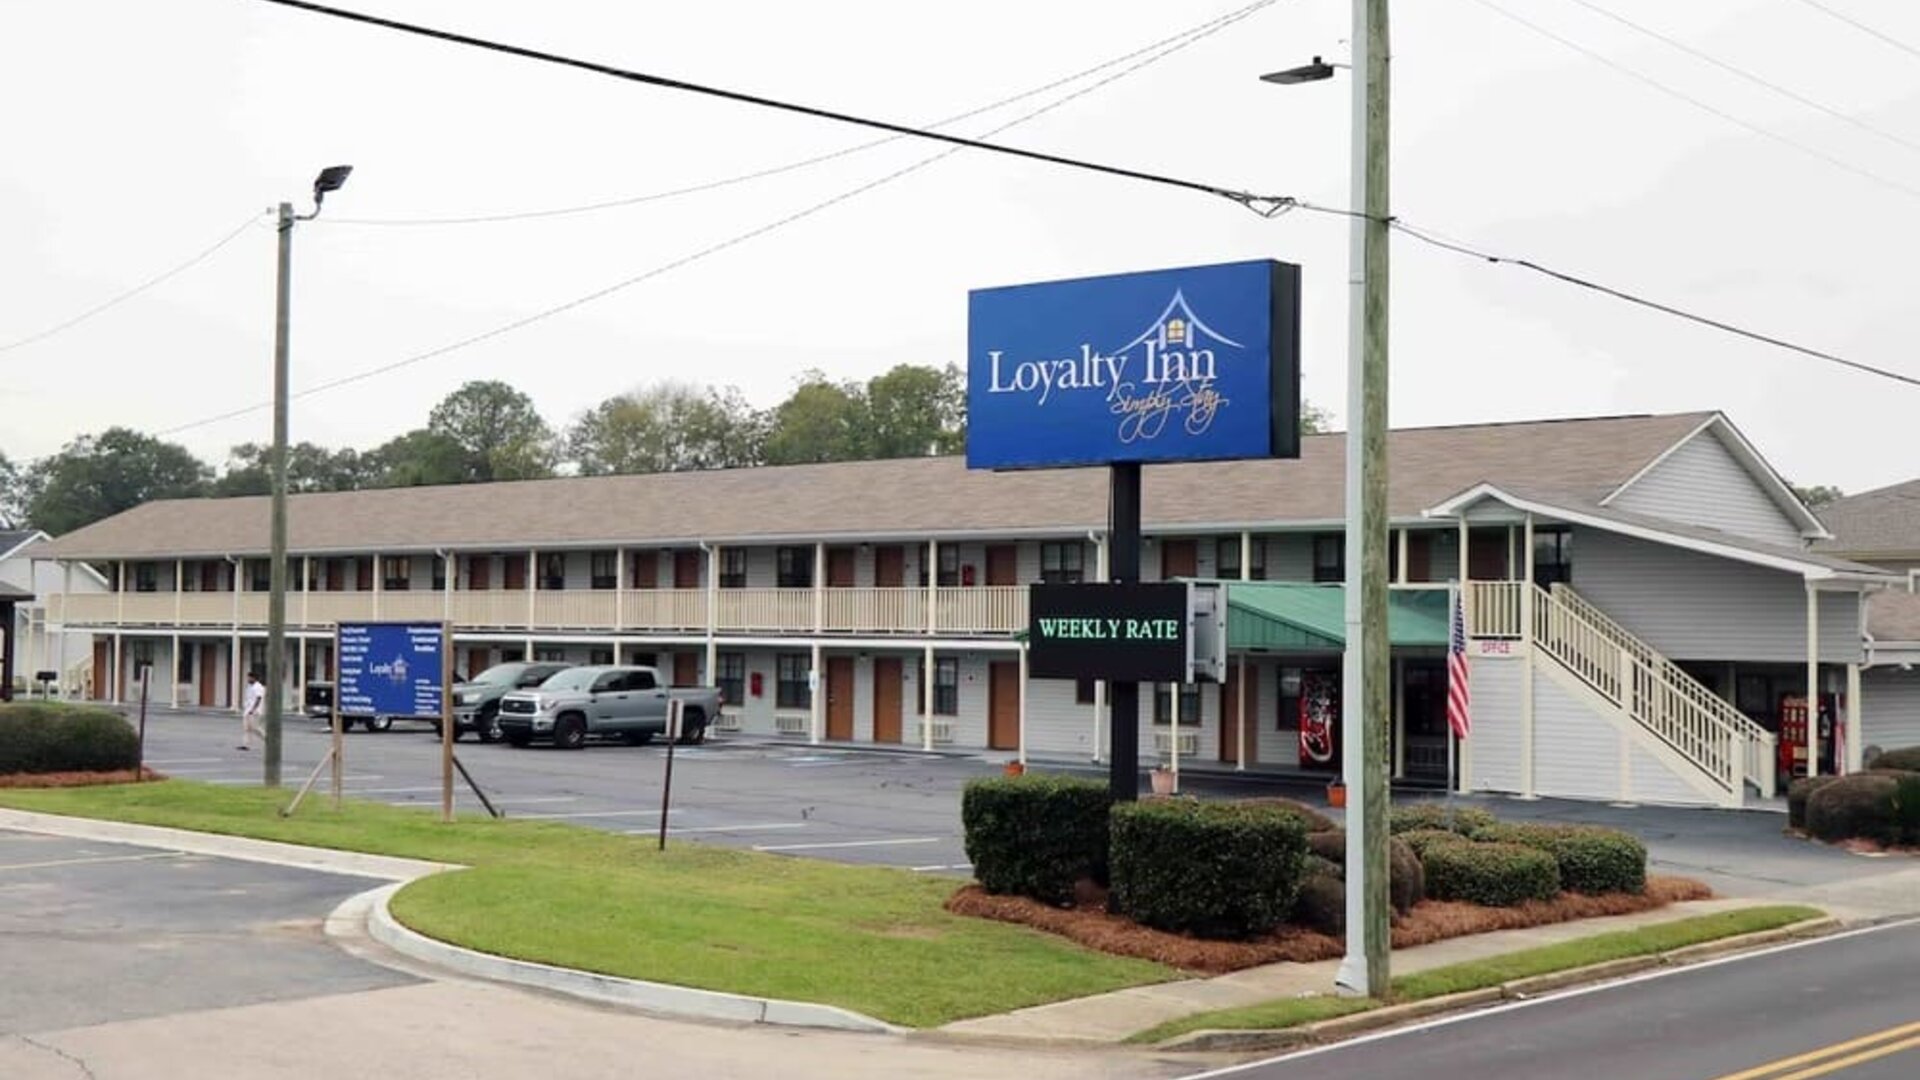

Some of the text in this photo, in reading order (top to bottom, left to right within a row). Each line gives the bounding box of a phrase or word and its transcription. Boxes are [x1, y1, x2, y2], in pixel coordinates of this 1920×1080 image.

[988, 339, 1218, 406] Loyalty Inn
[1111, 378, 1230, 443] Simply Stay
[1039, 618, 1179, 639] WEEKLY RATE
[1481, 641, 1510, 654] OFFICE
